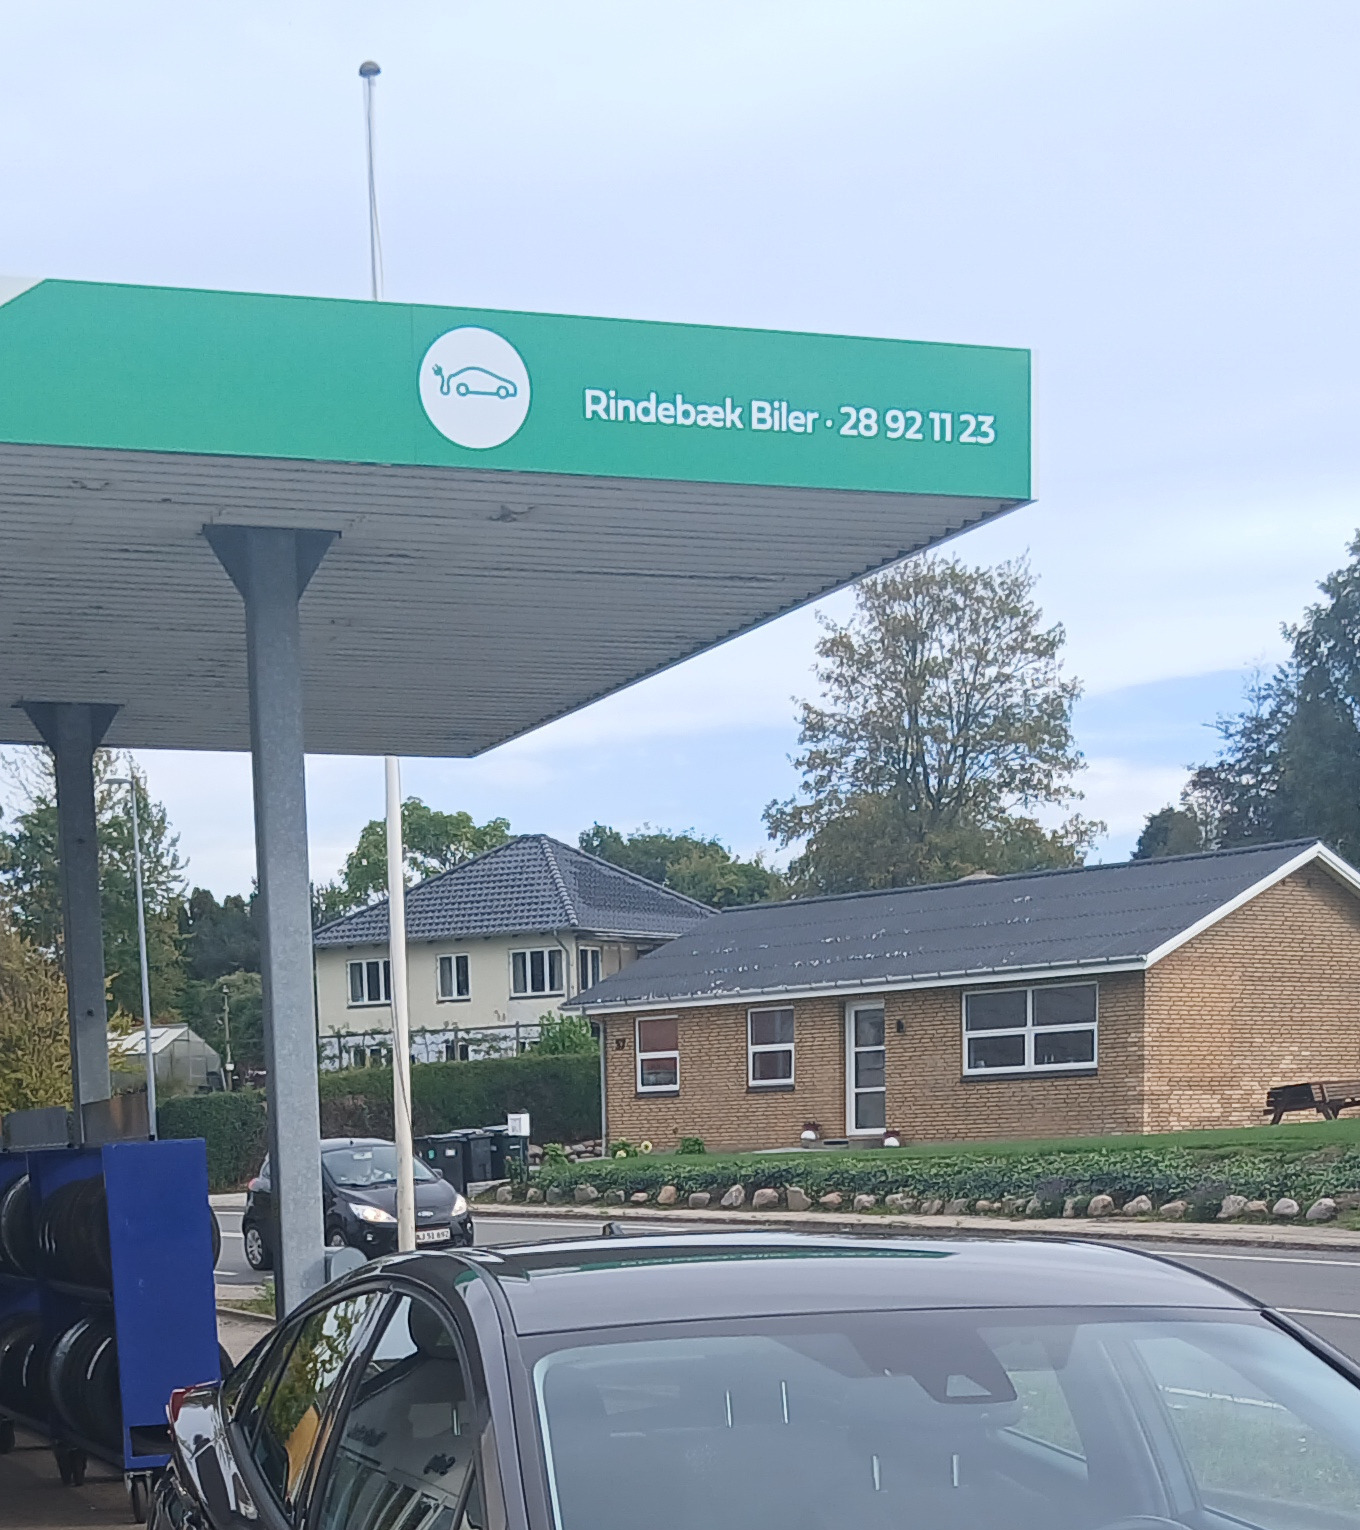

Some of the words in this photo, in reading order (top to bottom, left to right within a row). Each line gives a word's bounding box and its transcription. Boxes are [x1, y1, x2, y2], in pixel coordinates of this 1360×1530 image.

[584, 388, 745, 429] Rindebæk
[751, 400, 819, 433] Biler
[839, 406, 879, 437] 28
[885, 409, 924, 440] 92
[928, 411, 952, 442] 11
[959, 414, 996, 444] 23
